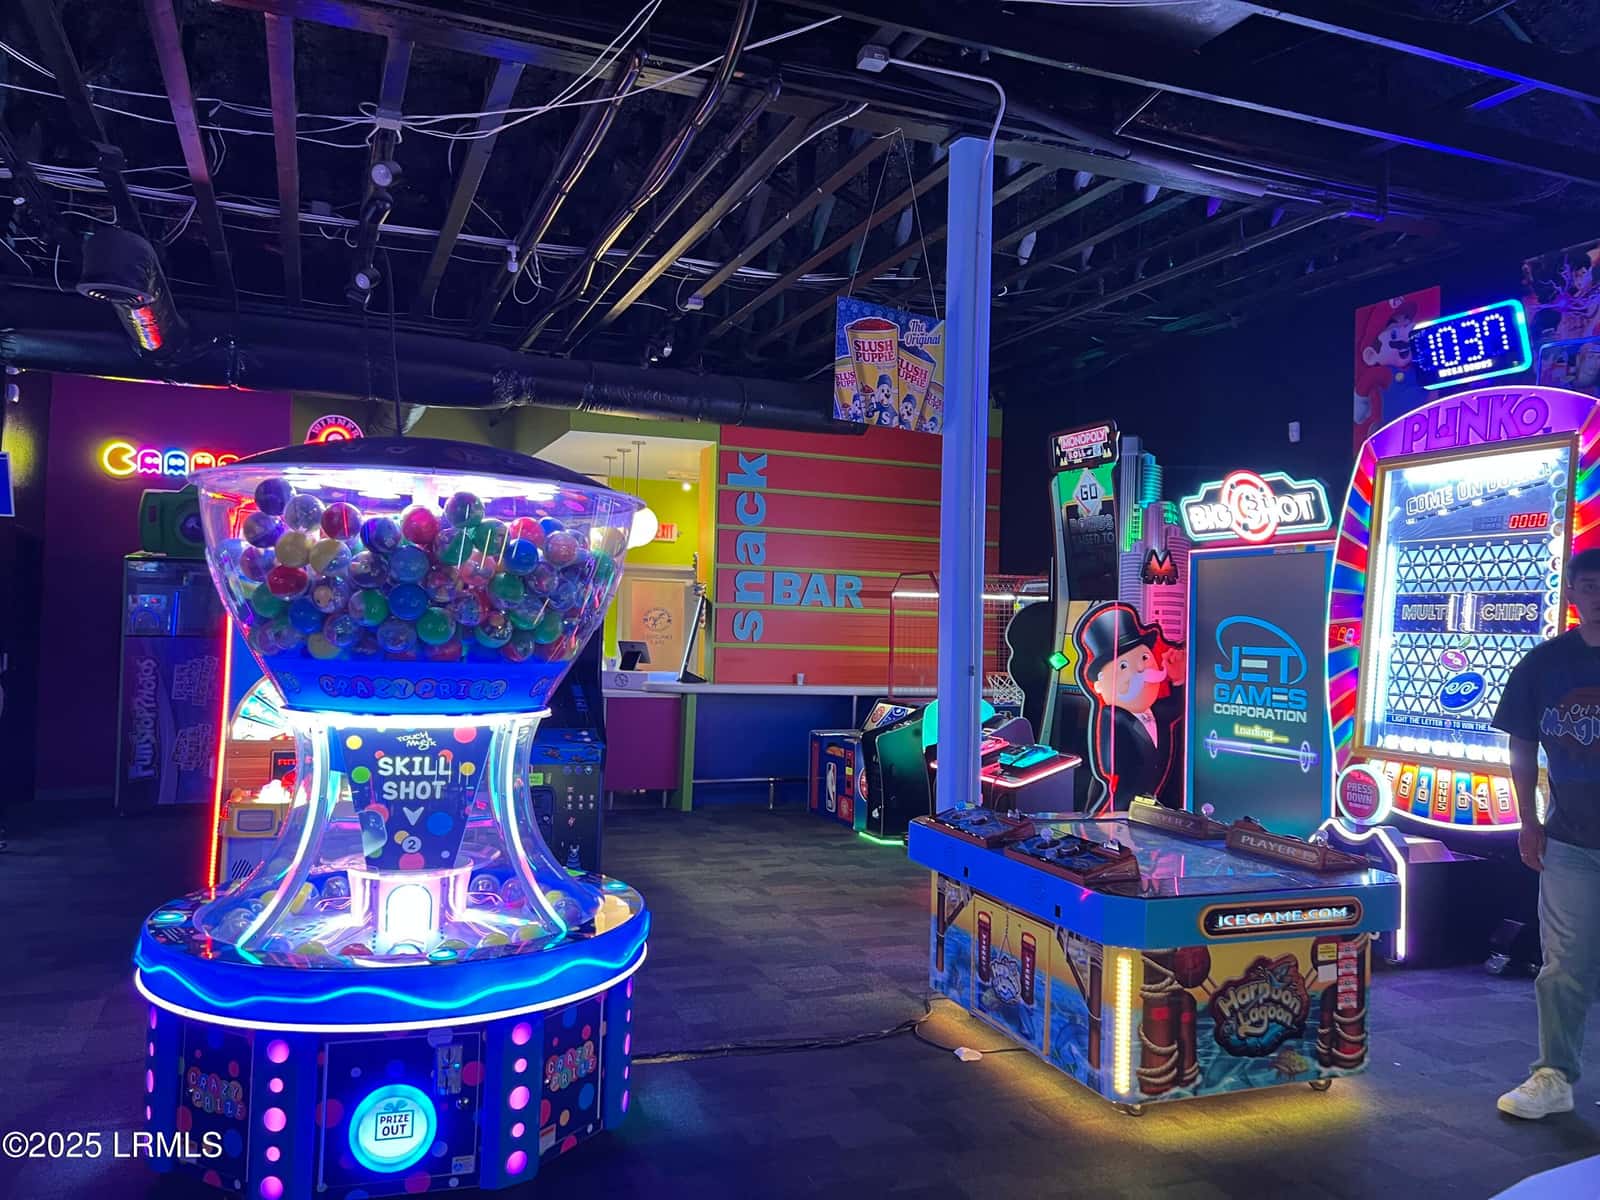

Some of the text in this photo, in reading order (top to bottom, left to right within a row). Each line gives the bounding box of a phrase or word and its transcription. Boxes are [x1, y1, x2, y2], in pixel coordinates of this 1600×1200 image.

[908, 320, 926, 333] The
[853, 339, 894, 353] SLUSH
[905, 332, 941, 348] Original
[1400, 392, 1550, 454] PLINKO
[1061, 428, 1107, 449] MONOPOLY
[1080, 483, 1098, 500] GO
[1188, 503, 1233, 532] BIG
[727, 451, 768, 642] snack
[772, 570, 864, 609] BAR
[1481, 603, 1539, 621] CHIPS
[1214, 646, 1300, 684] JET
[1213, 683, 1309, 711] GAMES
[1213, 703, 1308, 723] CORPORATION
[377, 755, 452, 777] SKILL
[382, 779, 447, 801] SHOT
[407, 838, 418, 850] 2
[1241, 835, 1297, 857] PLAYER
[1218, 906, 1348, 928] ICEGAME.COM
[1218, 980, 1301, 1017] Harpoon
[1236, 1003, 1294, 1038] Lagoon
[378, 1114, 410, 1126] PRIZE
[381, 1124, 407, 1138] OUT
